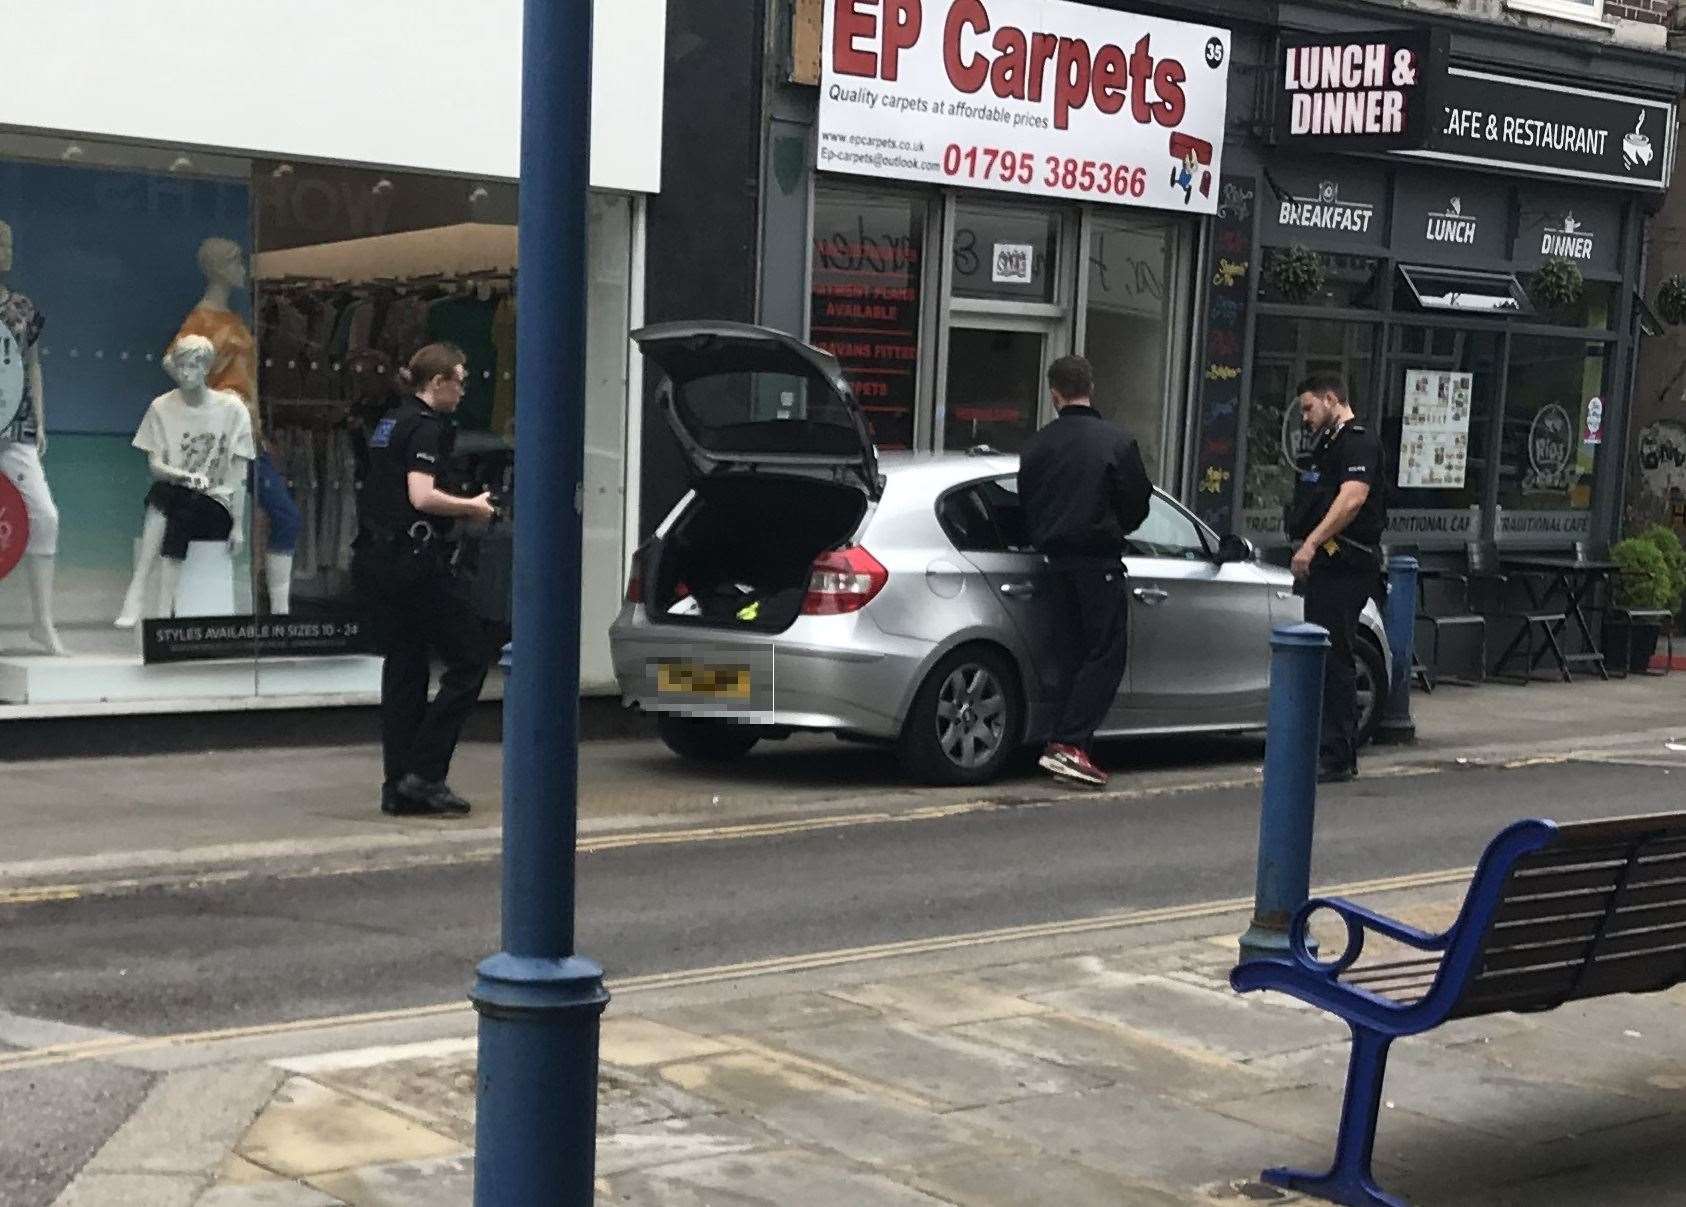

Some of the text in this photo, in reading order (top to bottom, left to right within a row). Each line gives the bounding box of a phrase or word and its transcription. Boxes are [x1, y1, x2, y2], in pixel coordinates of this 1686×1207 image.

[833, 0, 1186, 130] EP Carpets
[1206, 43, 1223, 61] 35
[1285, 44, 1416, 90] LUNCH &
[829, 84, 1048, 128] Quality carpets at affordable prices
[1290, 90, 1403, 135] DINNER
[1444, 107, 1609, 155] AFE & RESTAURANT
[943, 143, 1147, 198] 01795 385366
[1279, 202, 1373, 232] BREAKFAST
[1426, 218, 1476, 244] LUNCH
[1541, 234, 1593, 259] DINNER
[205, 625, 270, 639] AVAILABLE
[272, 625, 285, 637] IN
